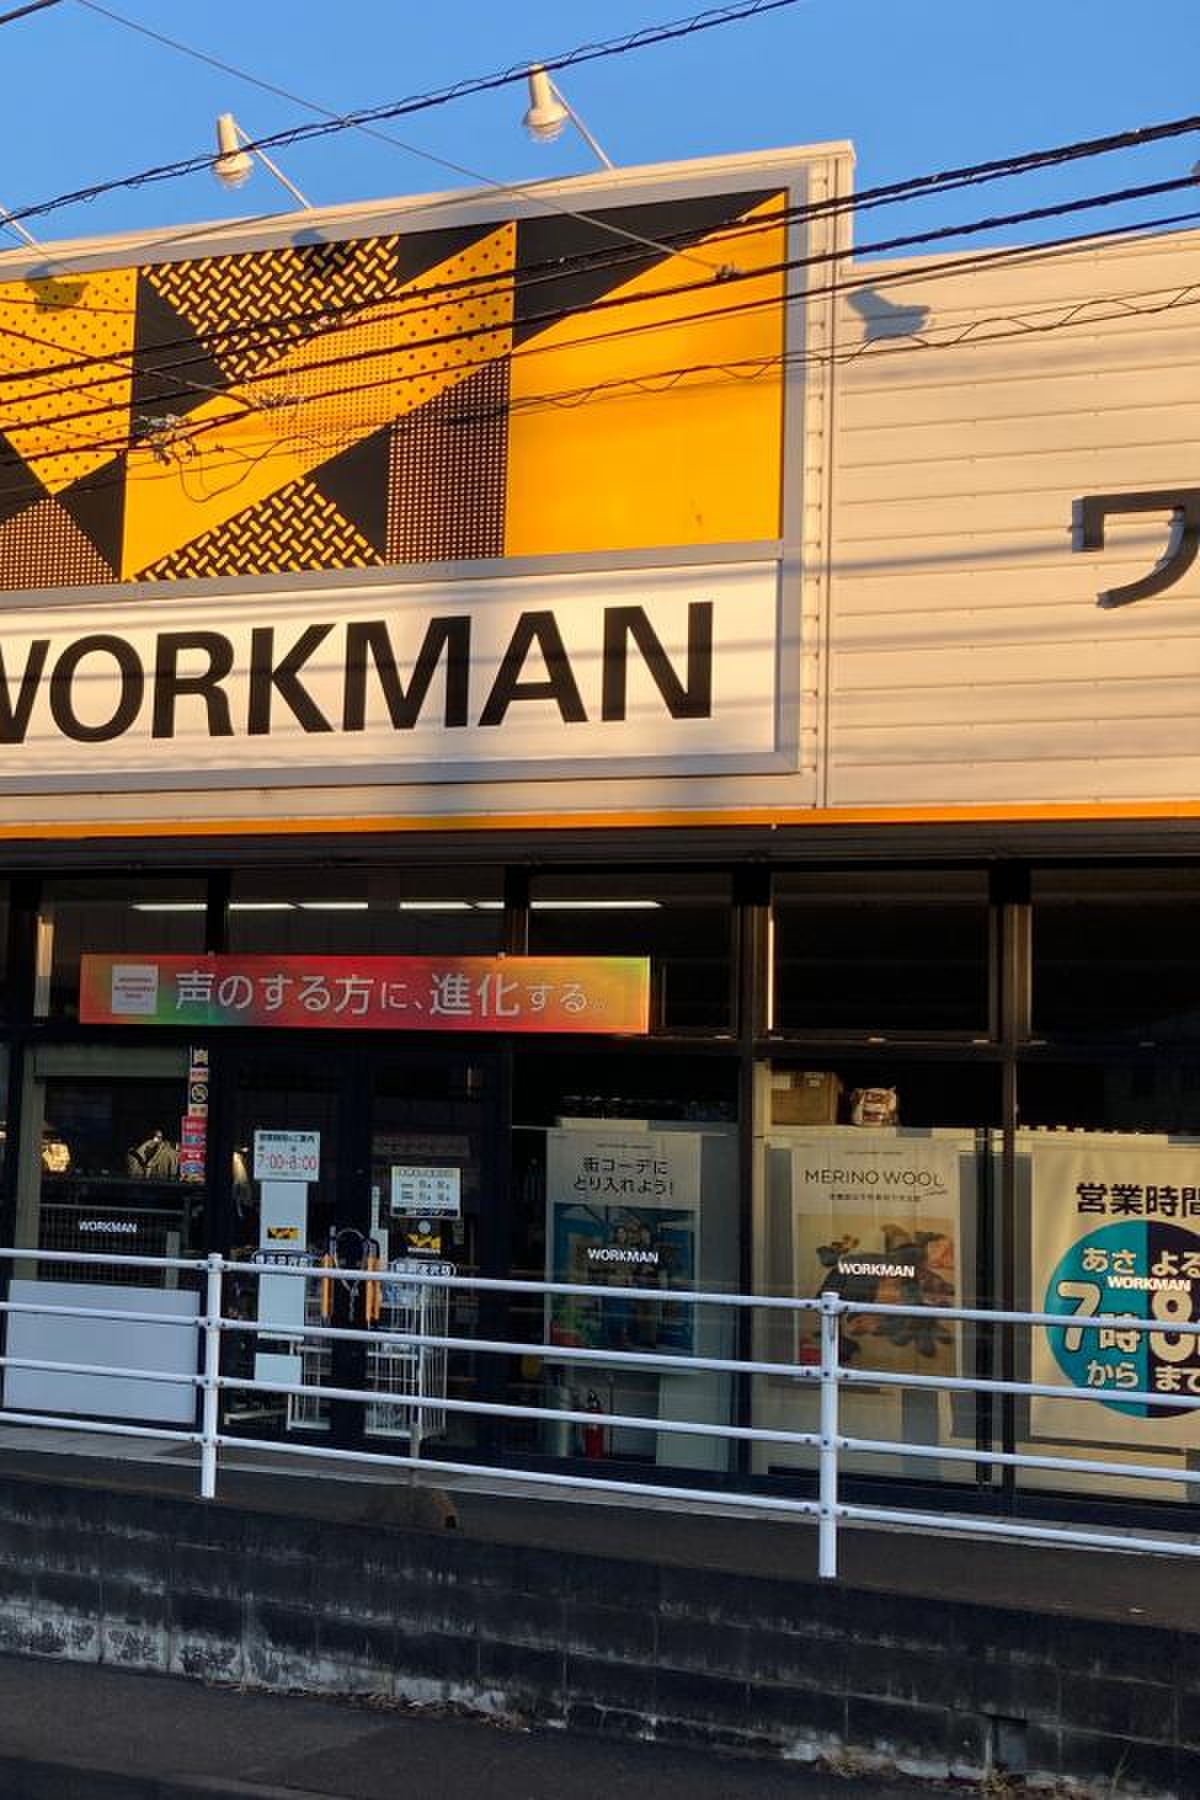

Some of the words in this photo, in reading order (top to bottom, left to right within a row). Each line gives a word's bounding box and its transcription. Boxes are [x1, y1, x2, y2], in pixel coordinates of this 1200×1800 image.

[175, 969, 606, 1017] 声のする方に、進化する
[583, 1157, 668, 1175] 街コーデに
[804, 1169, 879, 1186] MERINO
[883, 1171, 945, 1187] WOOL
[1076, 1183, 1200, 1217] 営業時間
[79, 1219, 138, 1233] WORKMAN
[588, 1247, 659, 1264] WORKMAN
[1081, 1249, 1137, 1274] あさ
[838, 1262, 915, 1278] WORKMAN
[1108, 1275, 1191, 1292] WORKMAN
[1087, 1359, 1138, 1388] から
